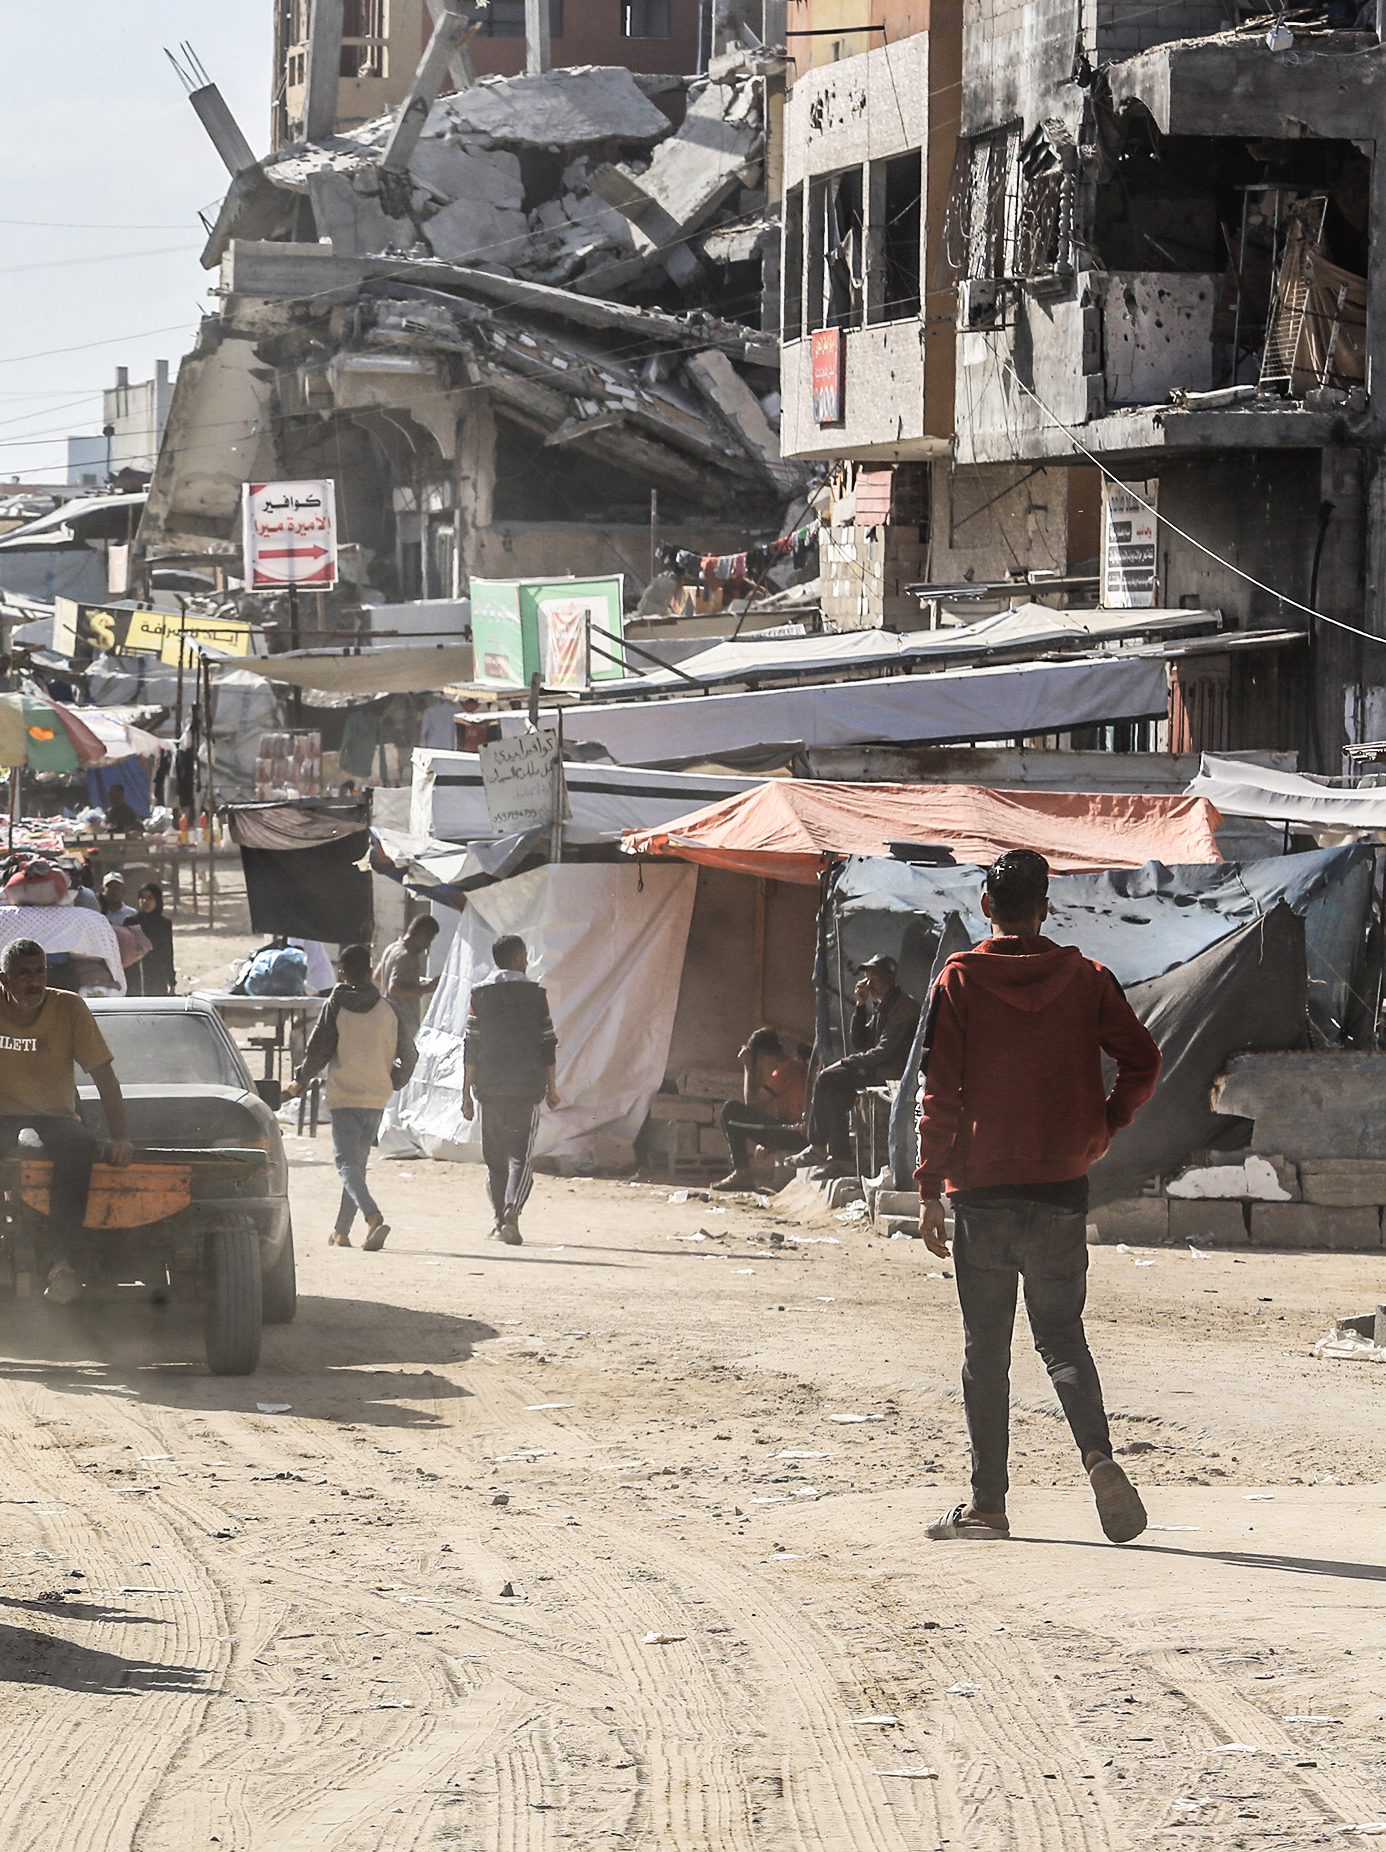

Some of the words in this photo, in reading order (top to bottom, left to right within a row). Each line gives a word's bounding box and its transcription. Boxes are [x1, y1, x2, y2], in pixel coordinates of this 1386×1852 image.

[262, 494, 321, 513] كوافير
[254, 519, 284, 538] ميرا
[287, 512, 331, 537] الأميرة
